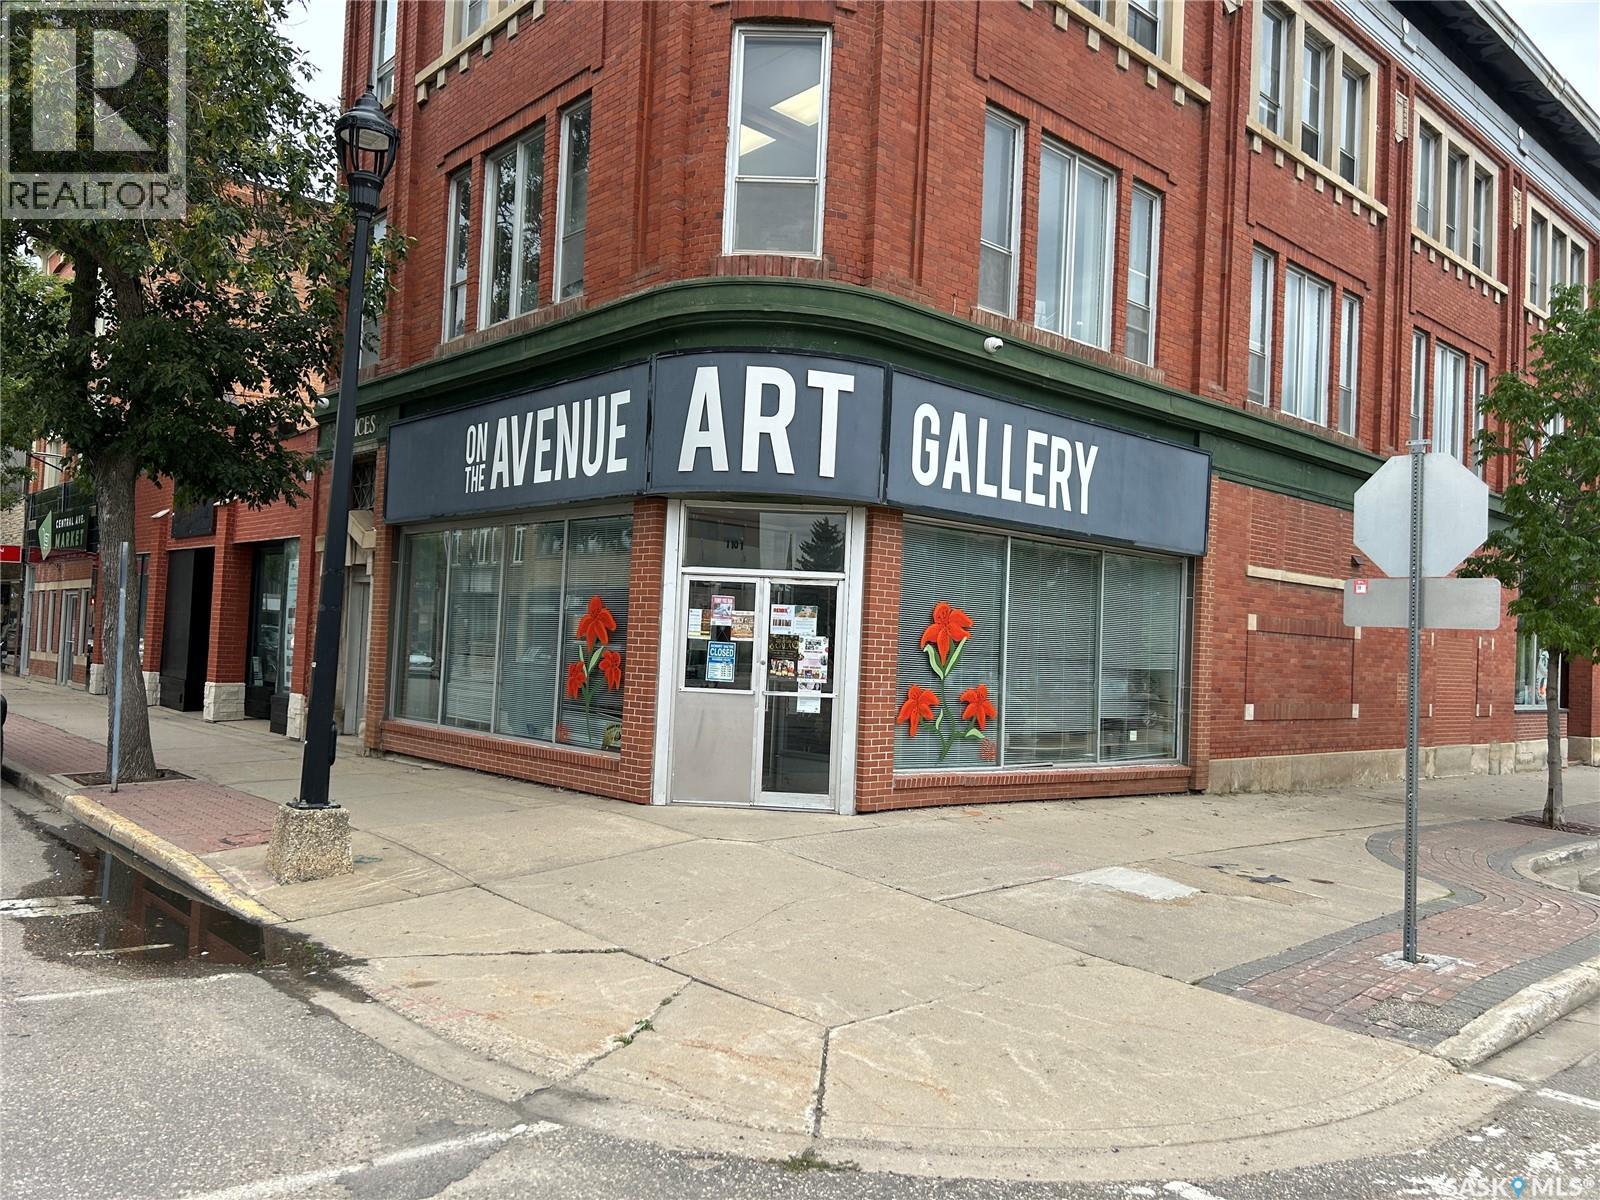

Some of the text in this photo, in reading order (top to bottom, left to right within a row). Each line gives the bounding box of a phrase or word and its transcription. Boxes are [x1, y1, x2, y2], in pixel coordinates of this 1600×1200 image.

[354, 414, 376, 437] ICES
[677, 365, 855, 479] ART
[465, 421, 488, 465] ON
[490, 390, 631, 490] AVENUE
[911, 402, 1100, 515] GALLERY
[464, 463, 486, 494] THE
[55, 516, 74, 529] CENTRAL
[54, 528, 84, 549] MARKET
[709, 647, 734, 657] CLOSED
